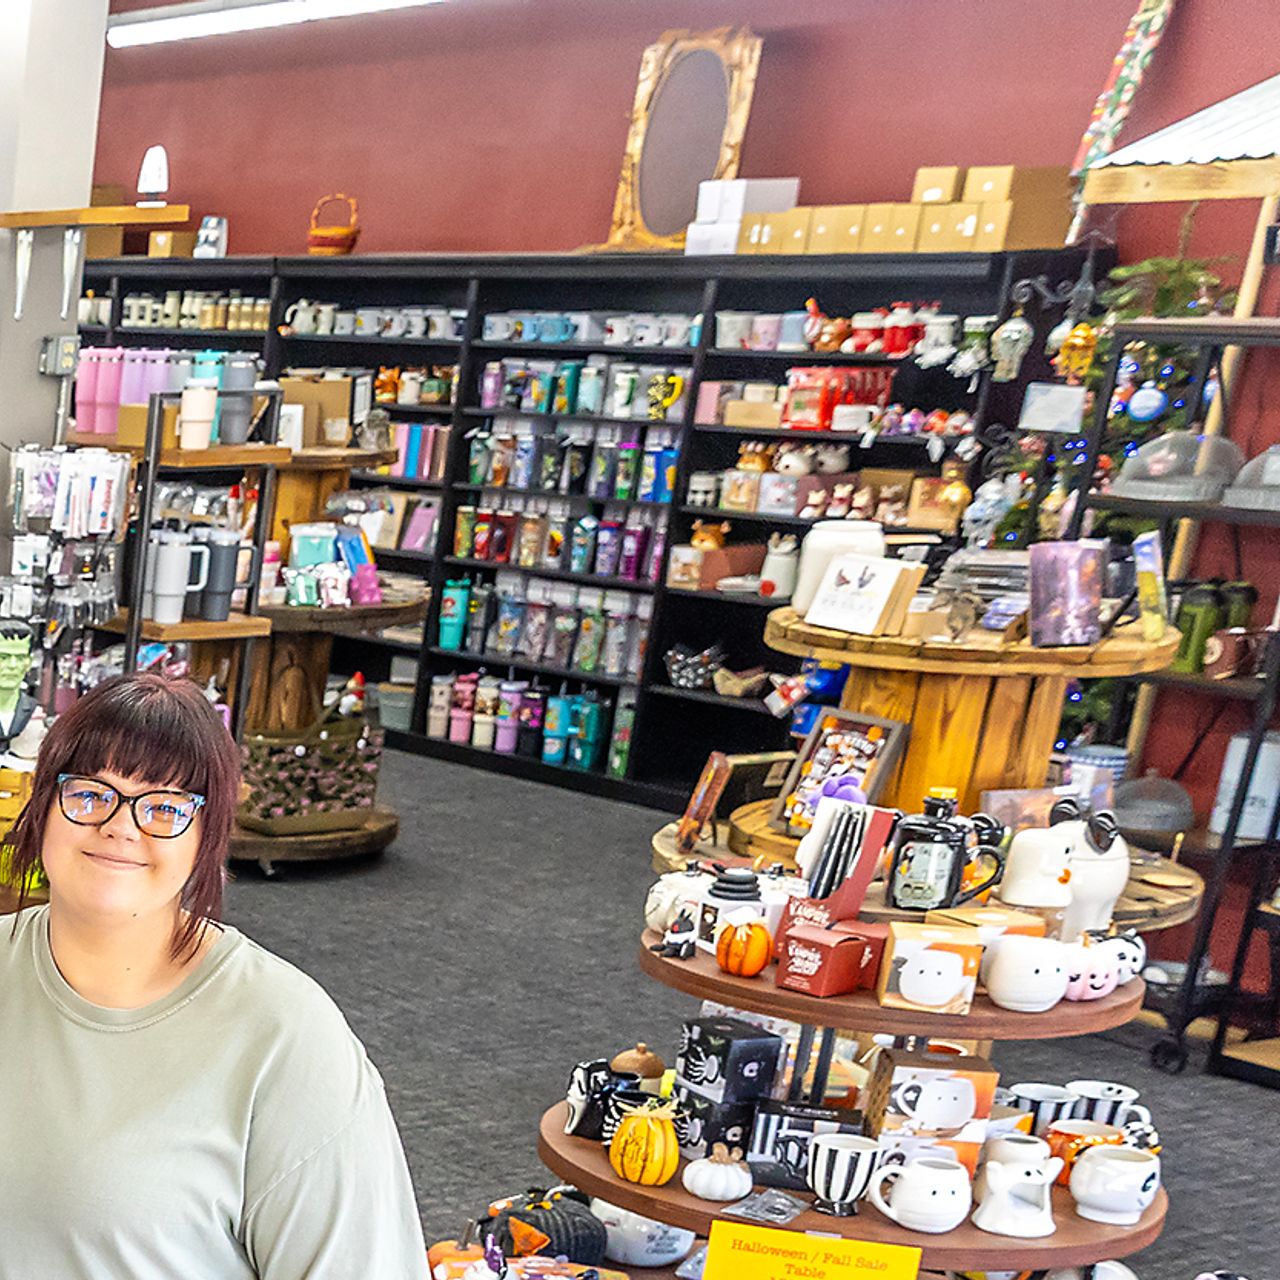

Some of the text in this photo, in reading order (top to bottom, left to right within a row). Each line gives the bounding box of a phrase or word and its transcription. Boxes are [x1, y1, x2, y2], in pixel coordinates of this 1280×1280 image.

[731, 1238, 889, 1272] Halloween / Fall Sale
[784, 1263, 826, 1280] Table
